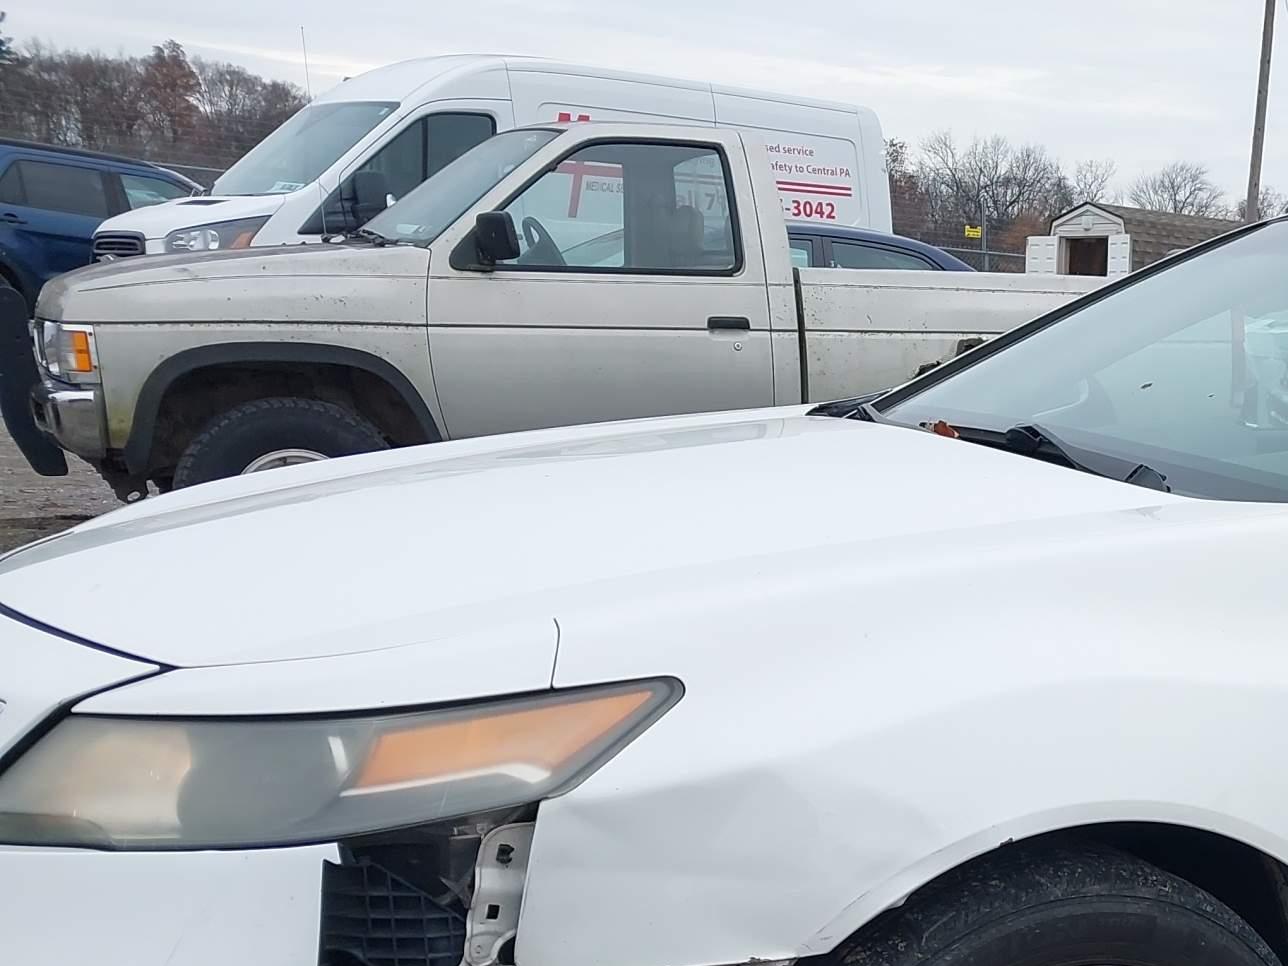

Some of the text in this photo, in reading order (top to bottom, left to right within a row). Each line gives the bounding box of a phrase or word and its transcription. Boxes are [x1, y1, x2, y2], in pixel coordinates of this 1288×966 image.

[783, 145, 814, 157] service
[795, 163, 804, 173] to
[806, 164, 838, 177] Central
[839, 167, 851, 177] PA
